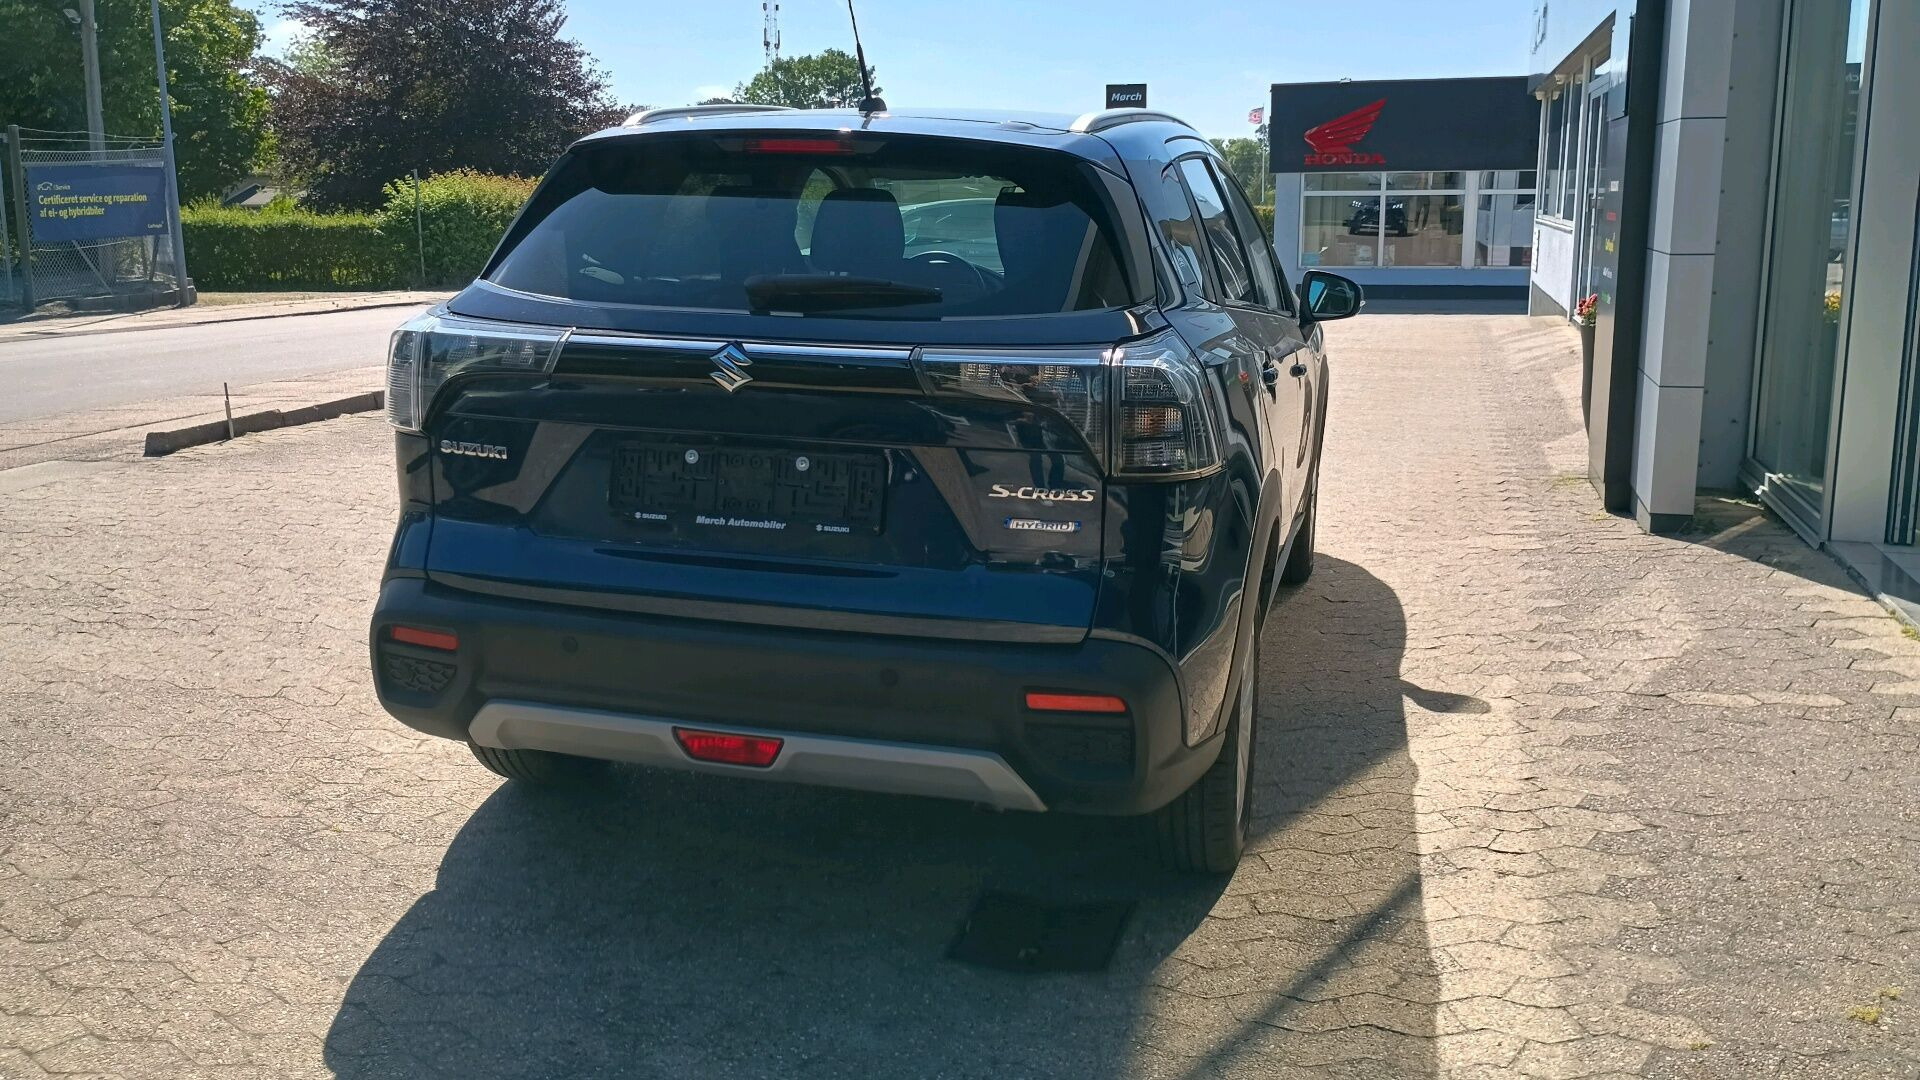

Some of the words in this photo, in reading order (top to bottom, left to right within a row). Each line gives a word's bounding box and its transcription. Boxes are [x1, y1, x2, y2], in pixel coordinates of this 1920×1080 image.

[1111, 92, 1142, 101] Mørch
[1304, 153, 1386, 166] HONDA
[39, 194, 78, 205] Certificeret
[80, 194, 103, 204] service
[104, 196, 112, 205] og
[113, 193, 147, 204] reparation
[40, 208, 47, 218] af
[48, 208, 58, 218] el-
[59, 209, 68, 220] og
[69, 206, 104, 218] hybridbiler
[440, 439, 507, 459] SUZUKI
[988, 483, 1097, 502] S-CROSS
[695, 515, 726, 526] Mørch
[728, 517, 786, 530] Automobiler
[823, 525, 850, 533] SUZUKI
[1015, 522, 1070, 531] HYBRID
